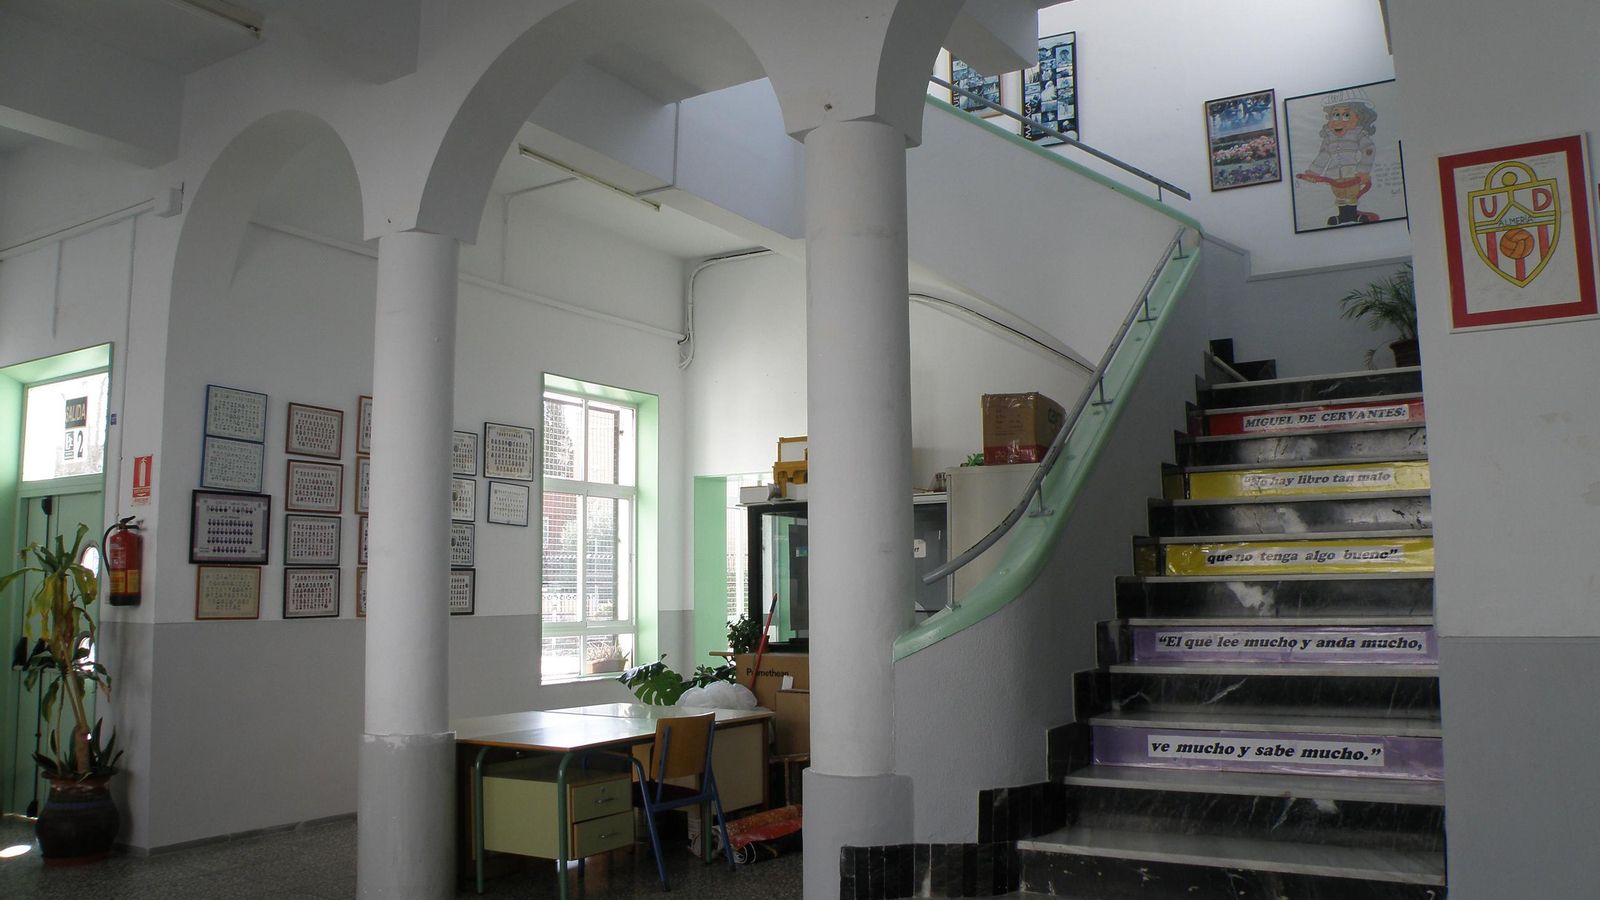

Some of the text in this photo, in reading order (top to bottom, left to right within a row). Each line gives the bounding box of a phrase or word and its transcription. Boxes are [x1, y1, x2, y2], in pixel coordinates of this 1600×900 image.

[1480, 187, 1553, 218] U D
[1245, 407, 1407, 428] MIGUEL DE CERVANTES:
[77, 430, 84, 458] 2
[1270, 476, 1295, 487] hay
[1297, 475, 1329, 485] libro
[1332, 474, 1353, 483] tan
[1357, 471, 1391, 482] malo
[1207, 554, 1232, 564] que
[1234, 553, 1253, 562] no
[1260, 551, 1298, 563] tenga
[1305, 550, 1336, 563] algo
[1184, 637, 1213, 649] que
[1217, 636, 1239, 648] lee
[1244, 636, 1297, 649] mucho
[1299, 638, 1311, 650] y
[1316, 637, 1355, 649] anda
[1359, 637, 1423, 650] mucho,
[1151, 743, 1170, 753] ve
[1176, 741, 1234, 755] mucho
[1237, 745, 1250, 758] y
[1255, 744, 1295, 757] sabe
